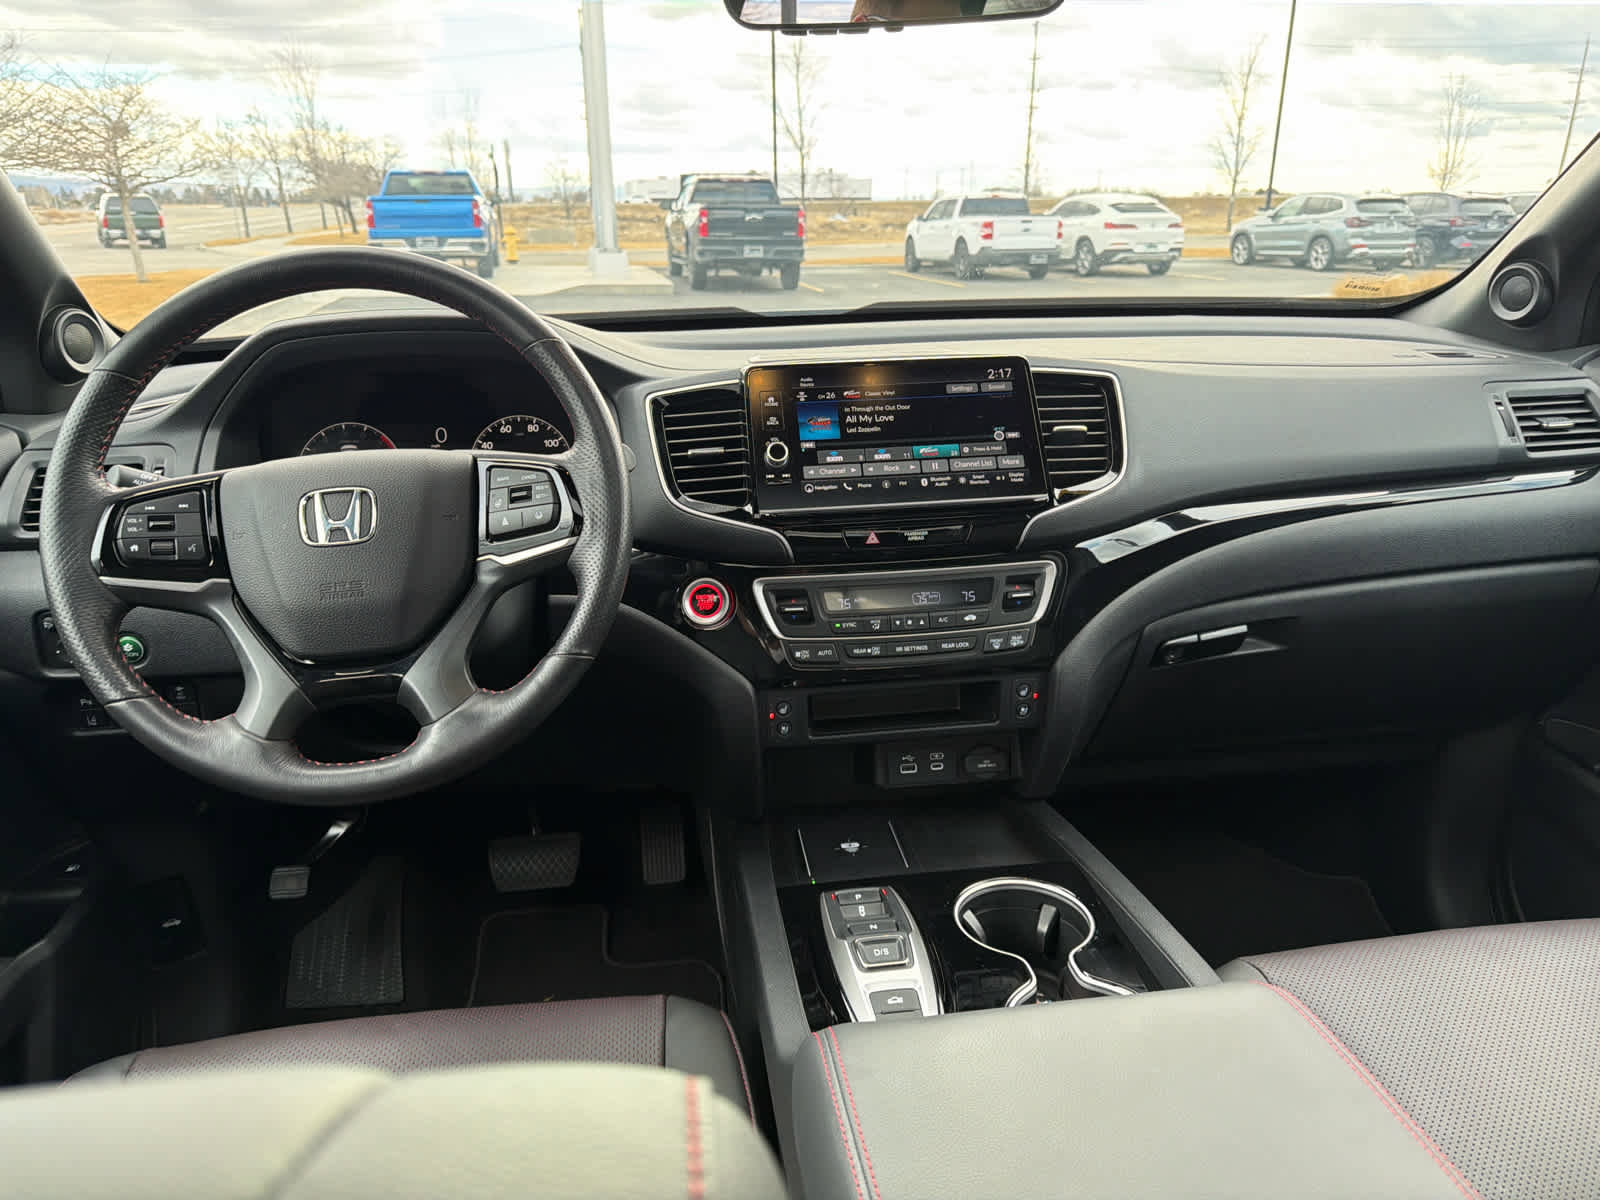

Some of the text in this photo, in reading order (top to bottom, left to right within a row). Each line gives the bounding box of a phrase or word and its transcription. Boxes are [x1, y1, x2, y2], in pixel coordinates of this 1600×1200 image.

[987, 368, 1012, 379] 2:17
[846, 414, 894, 424] All My Love
[500, 424, 512, 433] 60
[527, 424, 539, 433] 80
[435, 426, 448, 444] 0
[481, 441, 493, 449] 40
[543, 439, 559, 448] 100
[953, 460, 980, 468] Channel
[961, 590, 976, 602] 75
[873, 947, 889, 957] D/S
